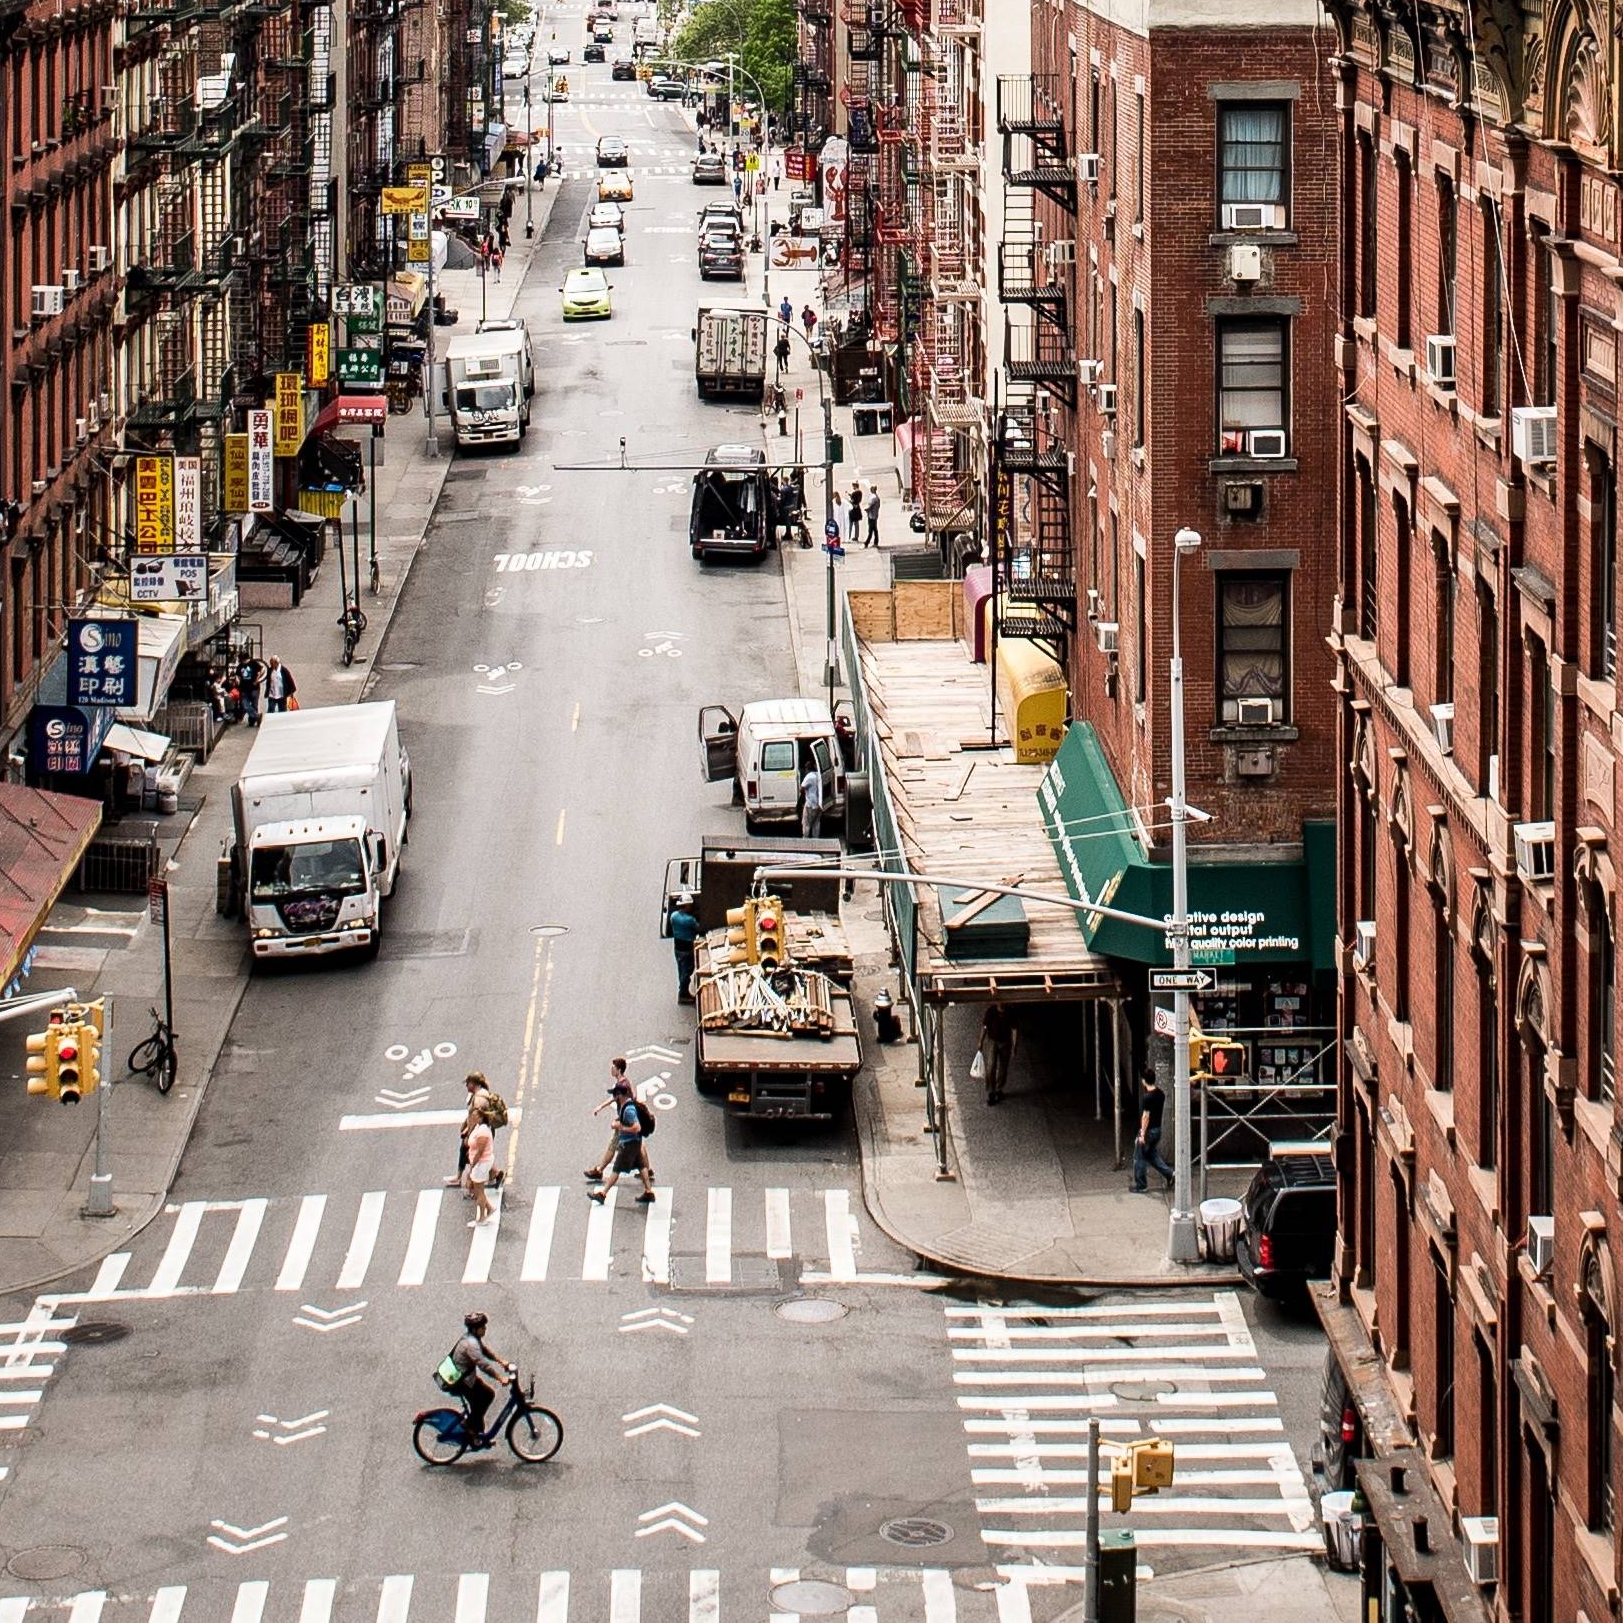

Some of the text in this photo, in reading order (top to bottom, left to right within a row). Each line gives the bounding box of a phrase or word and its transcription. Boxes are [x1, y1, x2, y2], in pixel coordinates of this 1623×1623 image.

[494, 550, 594, 572] SCHOOL
[180, 569, 197, 578] POS
[137, 590, 159, 598] CCTV
[80, 623, 122, 653] Sino
[79, 677, 124, 695] 印刷
[1221, 910, 1265, 925] design
[1210, 924, 1253, 937] output
[1191, 937, 1228, 949] quality
[1229, 937, 1256, 949] color
[1258, 936, 1299, 950] printing
[1159, 976, 1205, 985] ONE WAY
